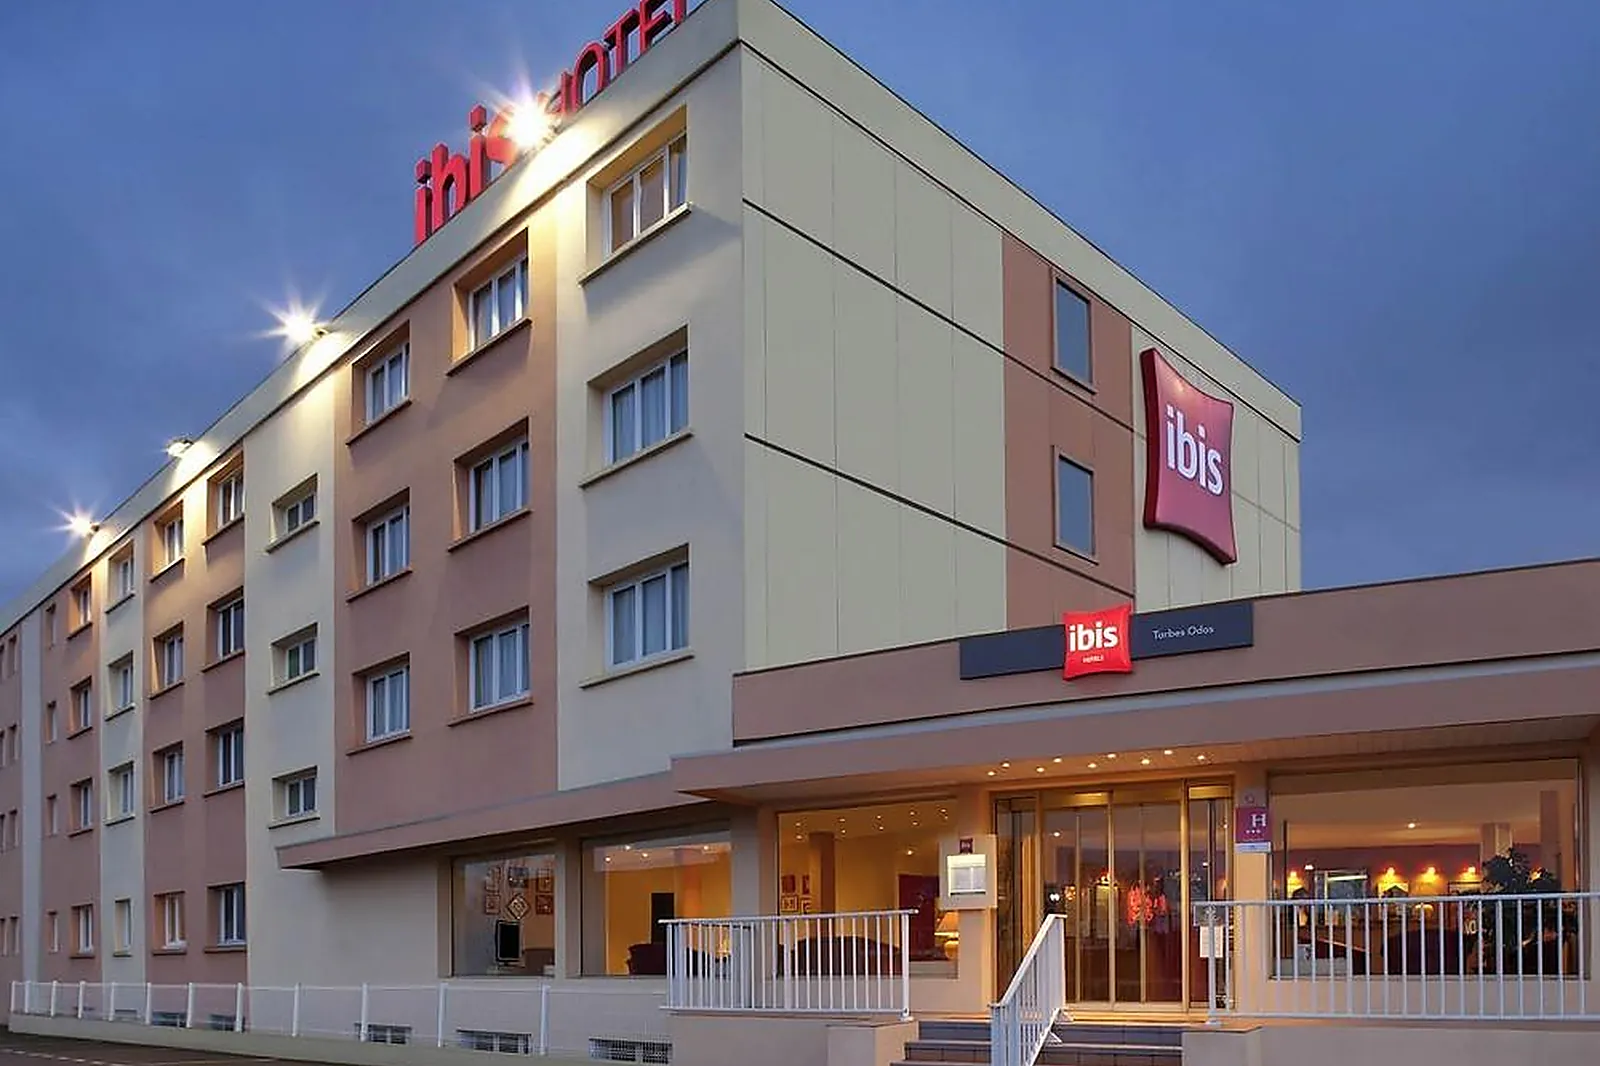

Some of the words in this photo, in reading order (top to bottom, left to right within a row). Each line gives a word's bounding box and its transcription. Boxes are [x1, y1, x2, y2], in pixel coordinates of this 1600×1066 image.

[1166, 404, 1223, 495] ibis
[1069, 620, 1118, 652] ibis
[1152, 628, 1185, 640] Tarbes
[1187, 625, 1214, 636] Odos
[1251, 813, 1267, 828] H
